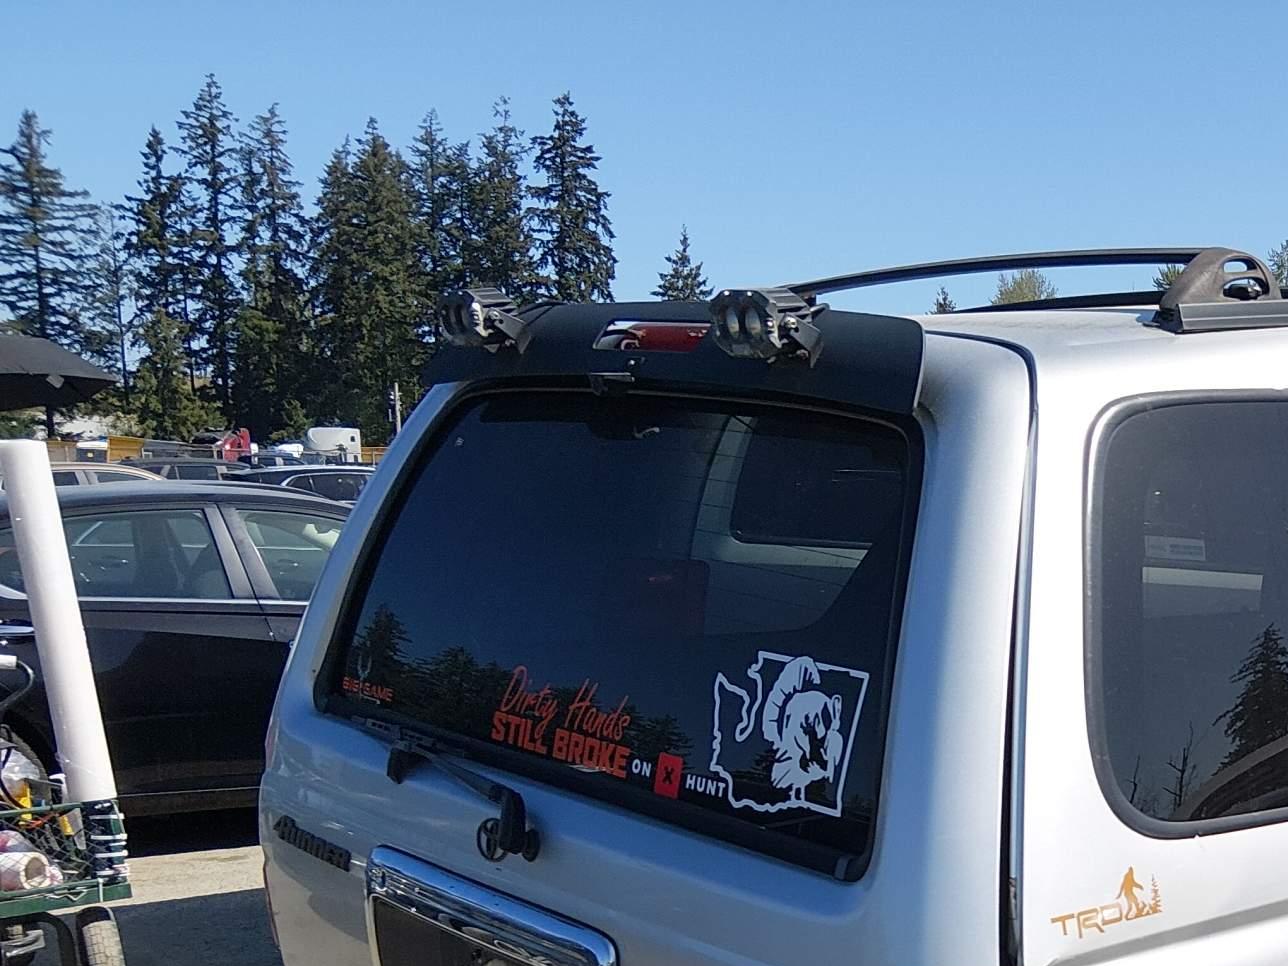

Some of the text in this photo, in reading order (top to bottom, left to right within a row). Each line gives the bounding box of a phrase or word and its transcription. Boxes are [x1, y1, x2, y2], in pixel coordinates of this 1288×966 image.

[501, 665, 631, 741] Dirty Hands
[491, 711, 631, 778] STILL BROKE
[632, 758, 651, 778] ON
[685, 774, 726, 798] HUNT
[1051, 902, 1123, 939] TRD
